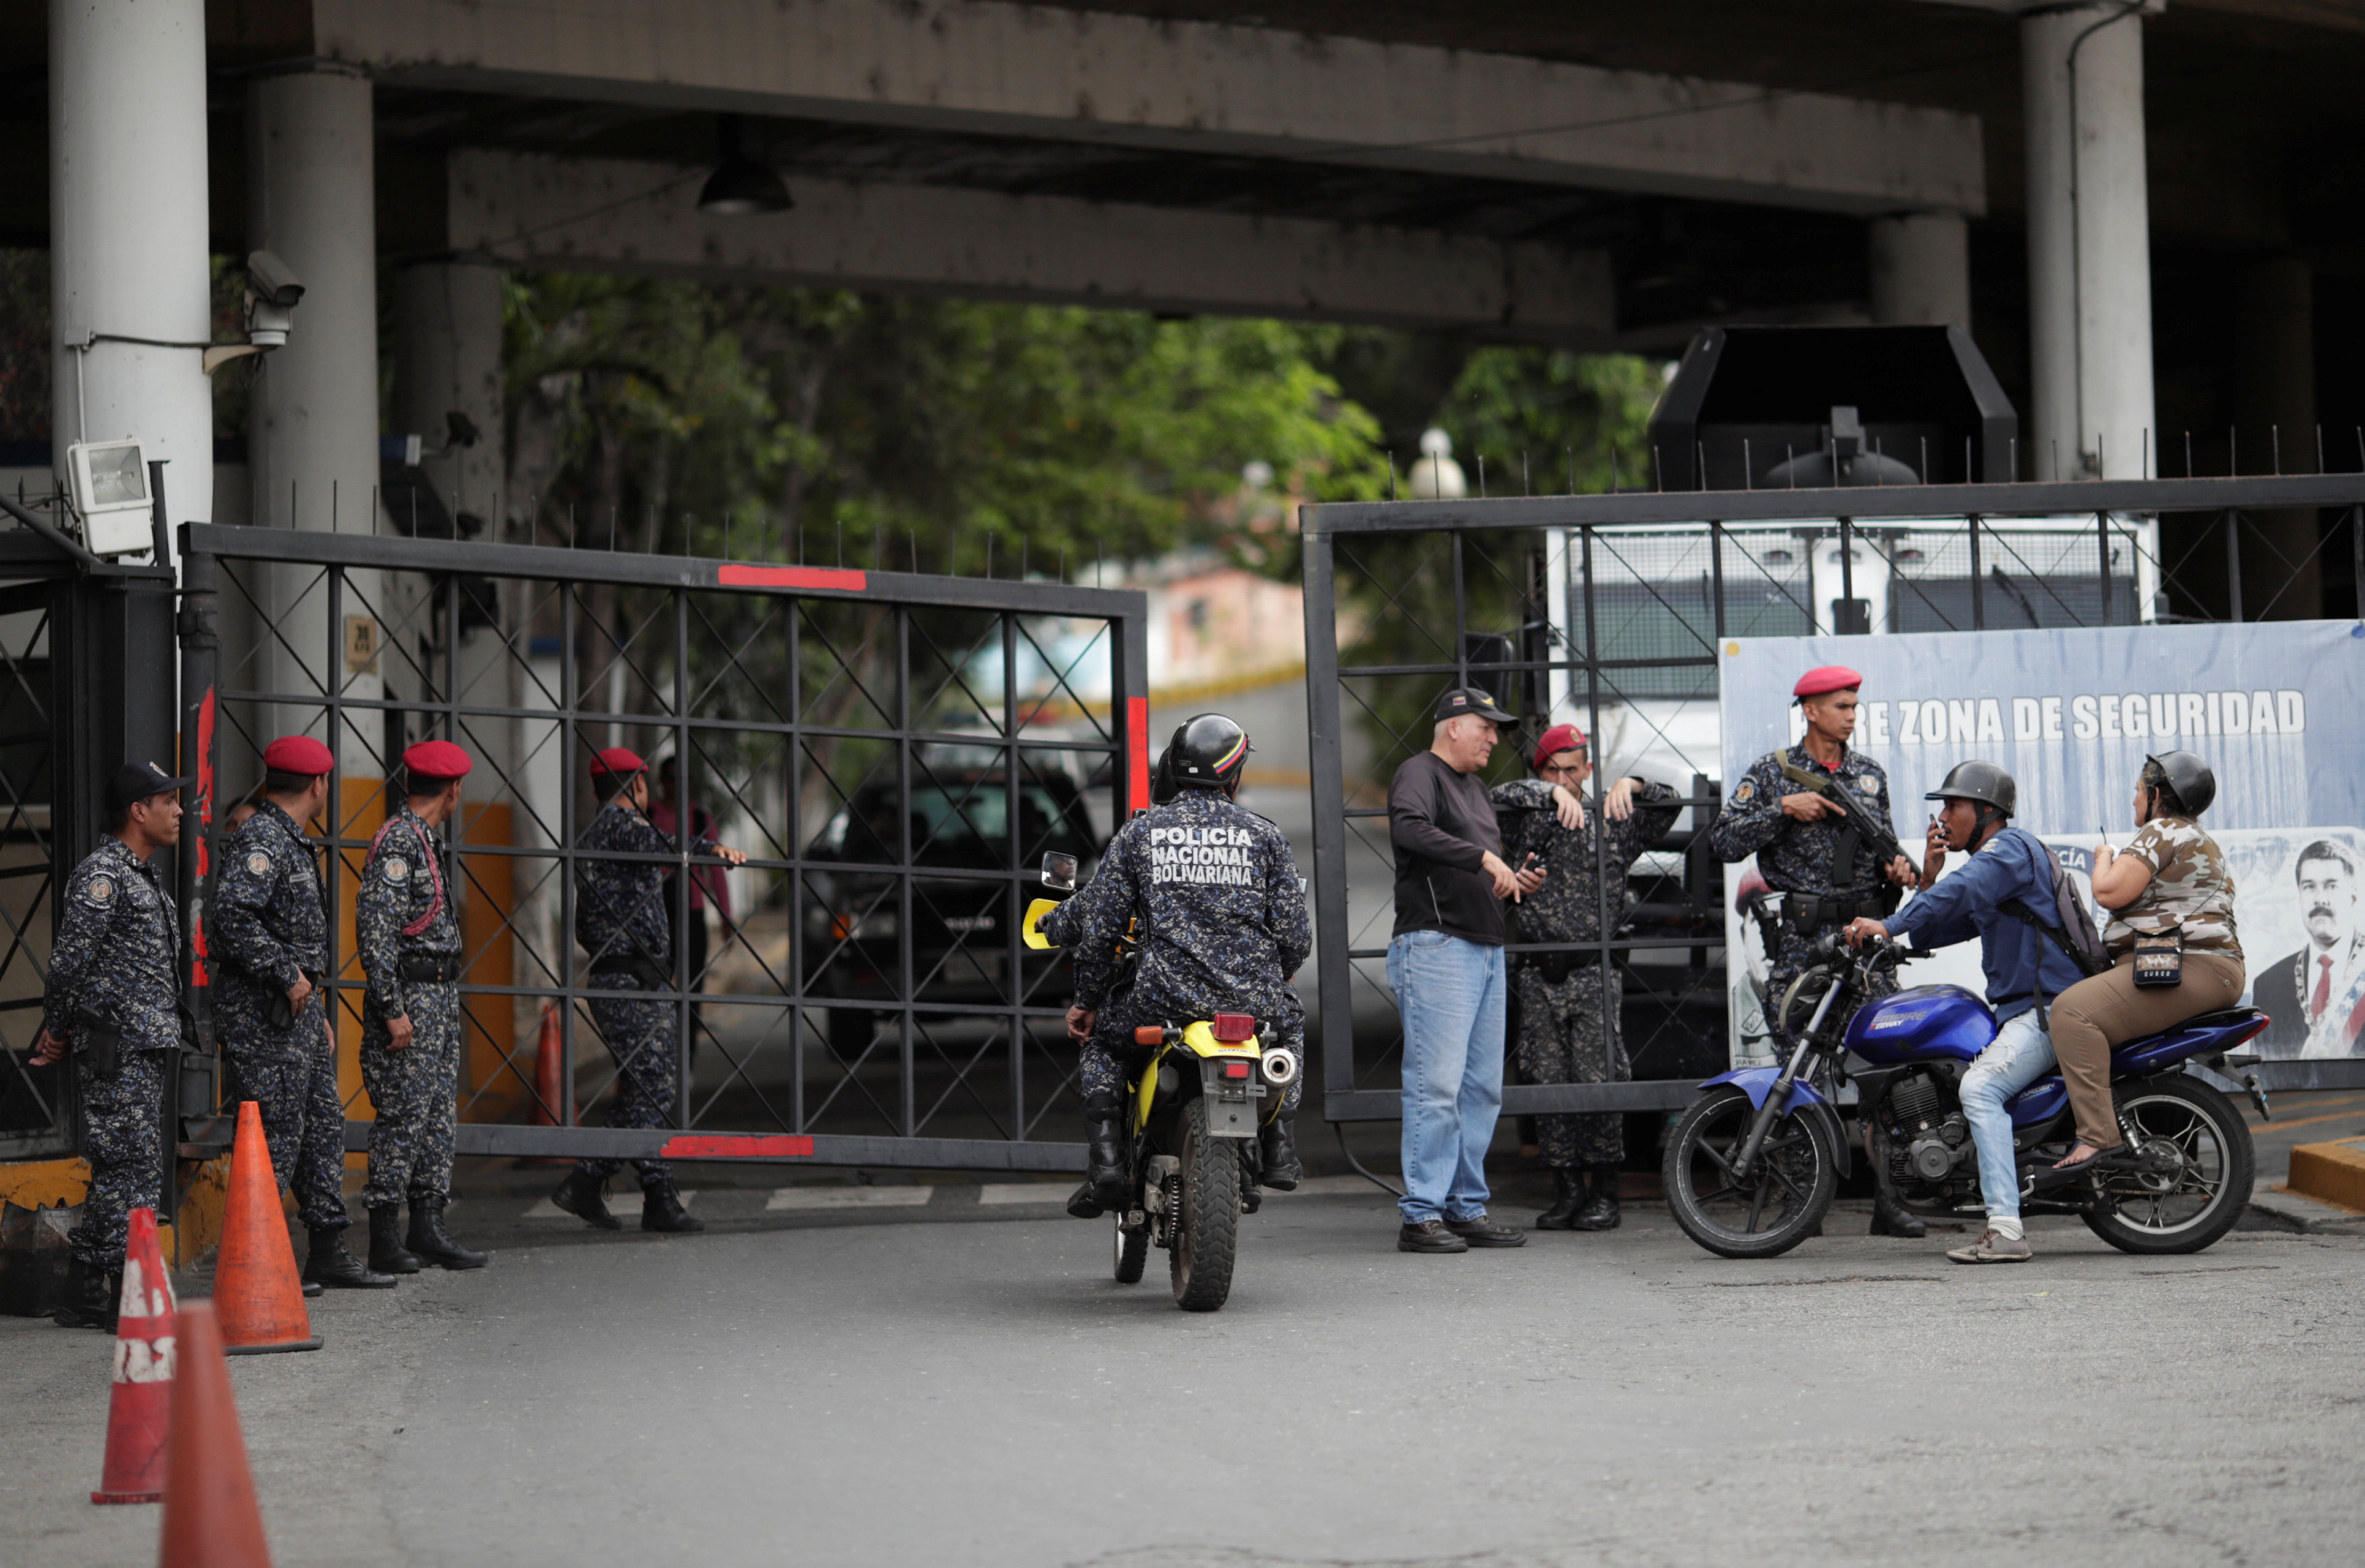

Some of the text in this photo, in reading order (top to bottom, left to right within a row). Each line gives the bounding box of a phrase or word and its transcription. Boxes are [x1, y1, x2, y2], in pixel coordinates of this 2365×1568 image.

[1788, 689, 2306, 747] PRE ZONA DE SEGURIDAD
[1151, 846, 1253, 866] NACIONAL
[2055, 847, 2087, 869] CÍA
[1152, 864, 1253, 886] BOLIVARIANA
[1870, 1011, 1929, 1024] EMPIRE
